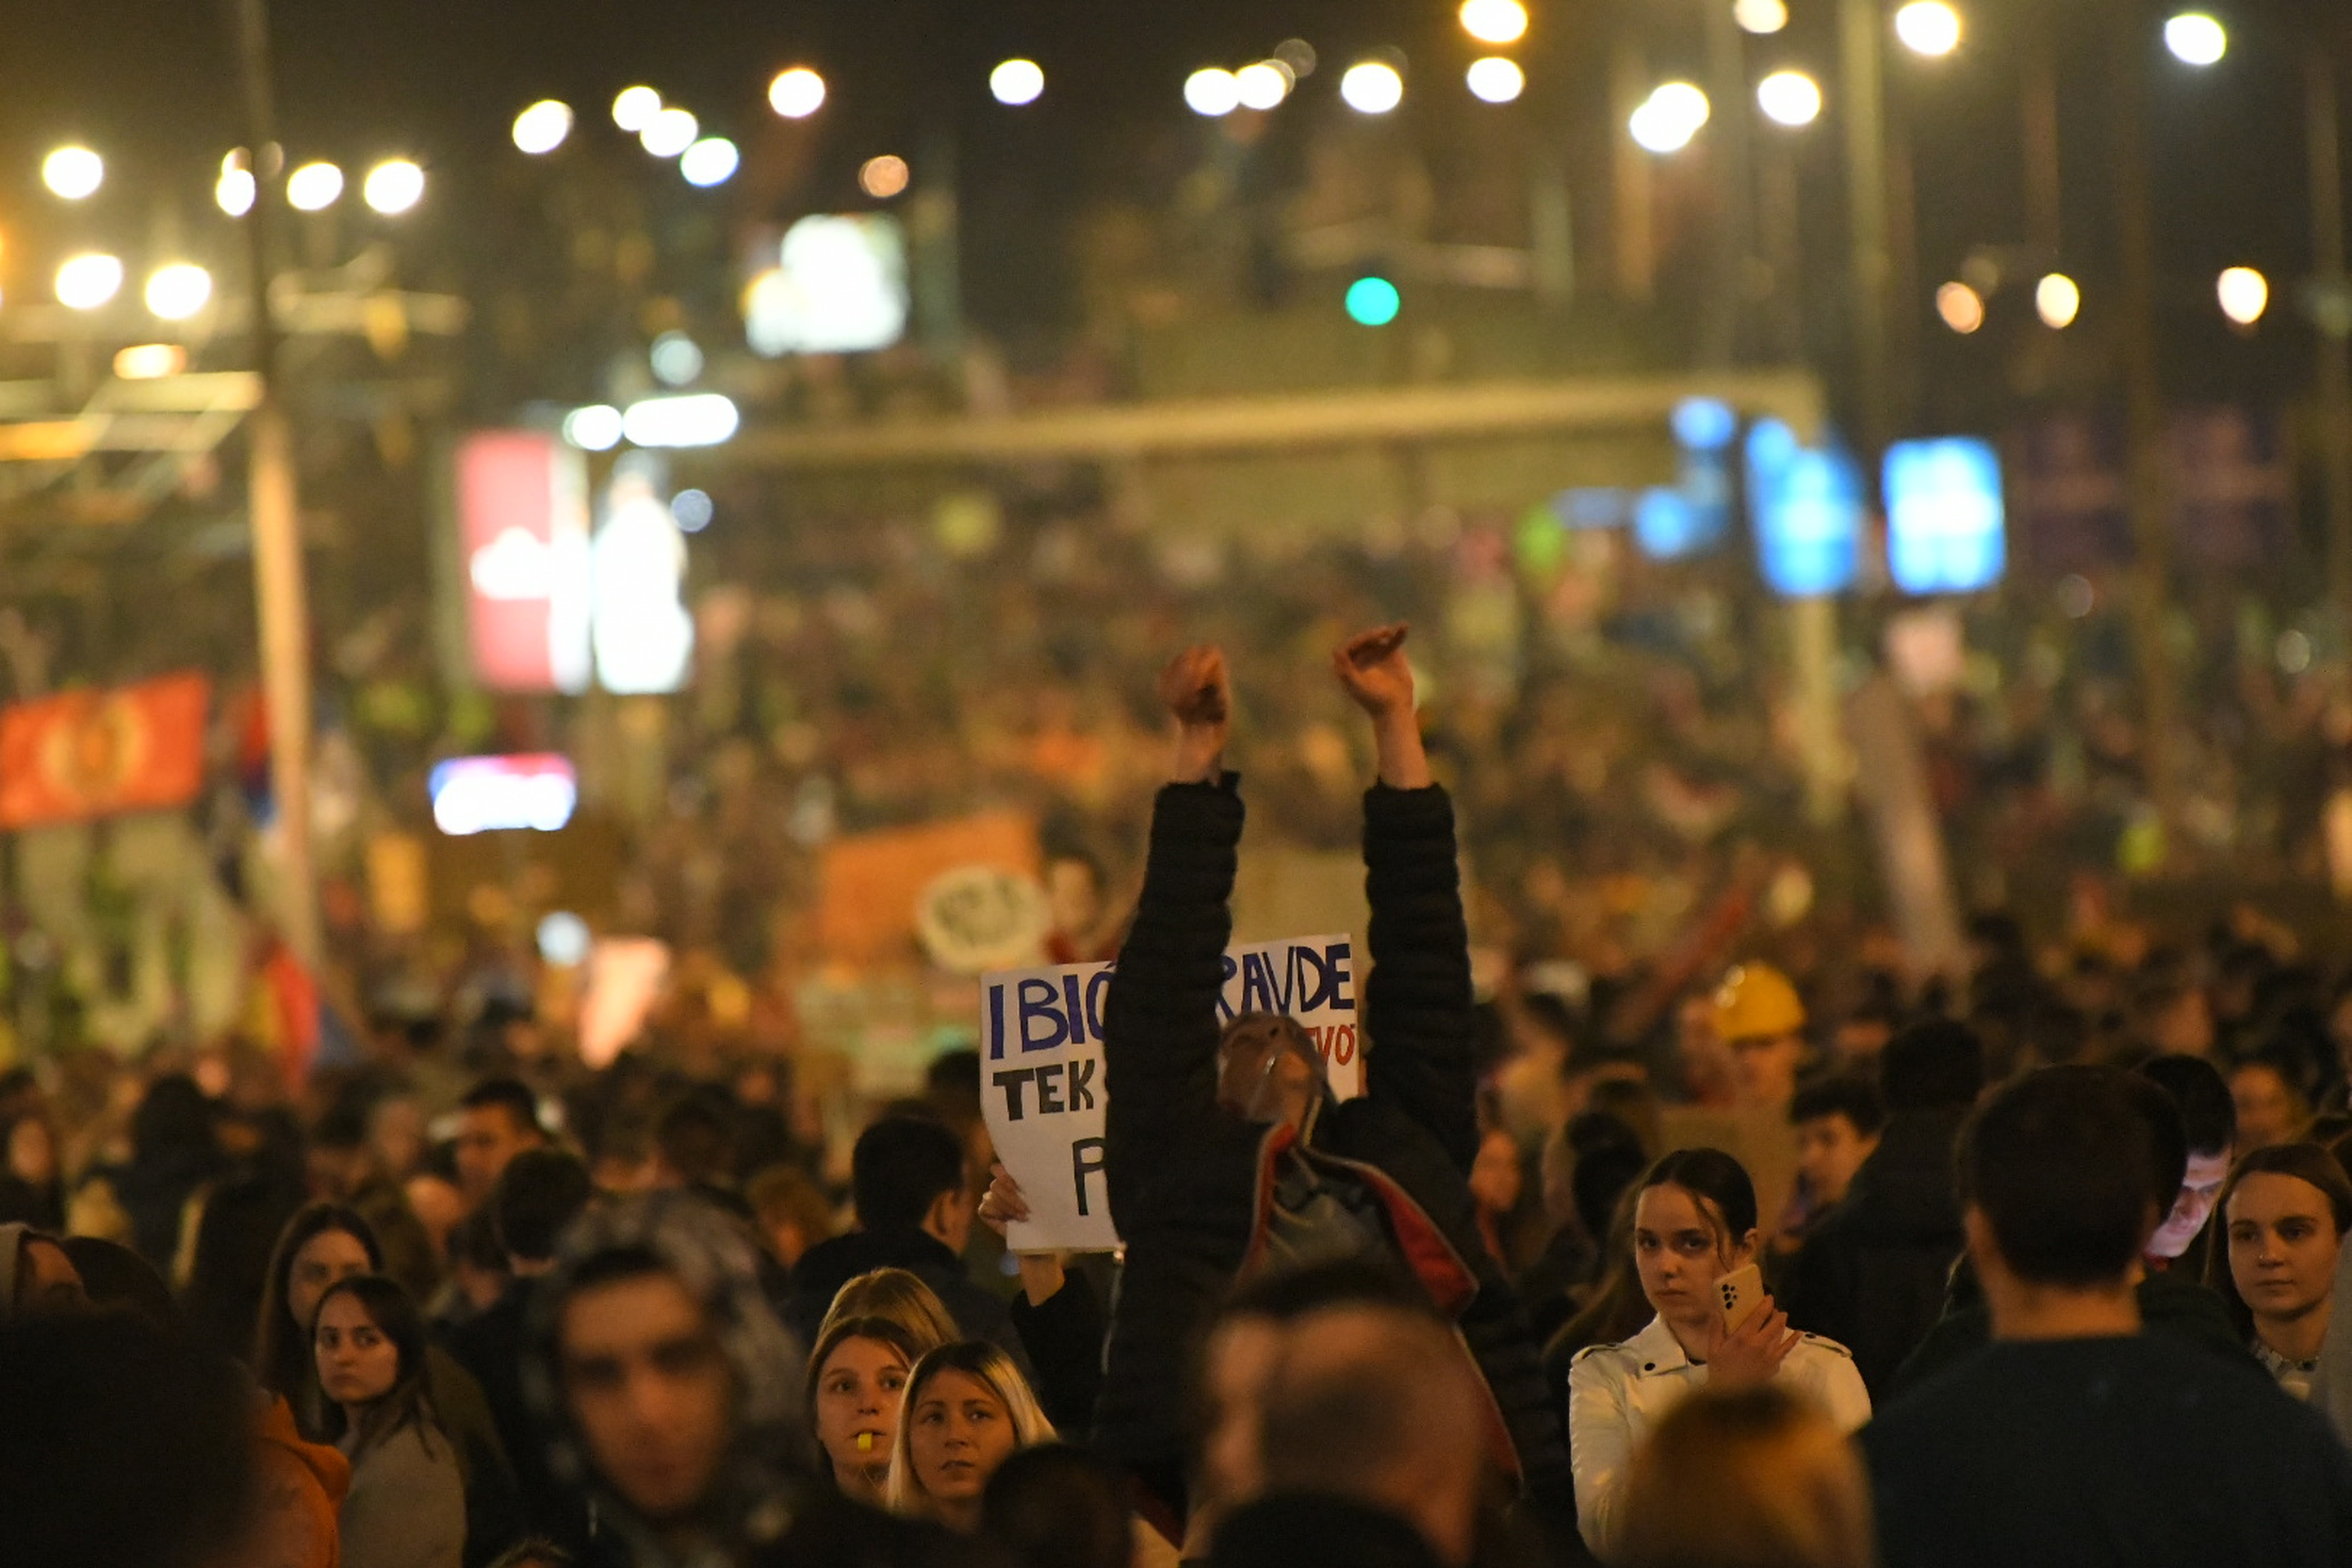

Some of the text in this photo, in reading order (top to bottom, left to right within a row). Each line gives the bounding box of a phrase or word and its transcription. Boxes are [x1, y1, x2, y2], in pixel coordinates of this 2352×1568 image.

[990, 985, 1004, 1060] I
[1215, 943, 1355, 1022] RAVDE
[1072, 1137, 1105, 1216] P
